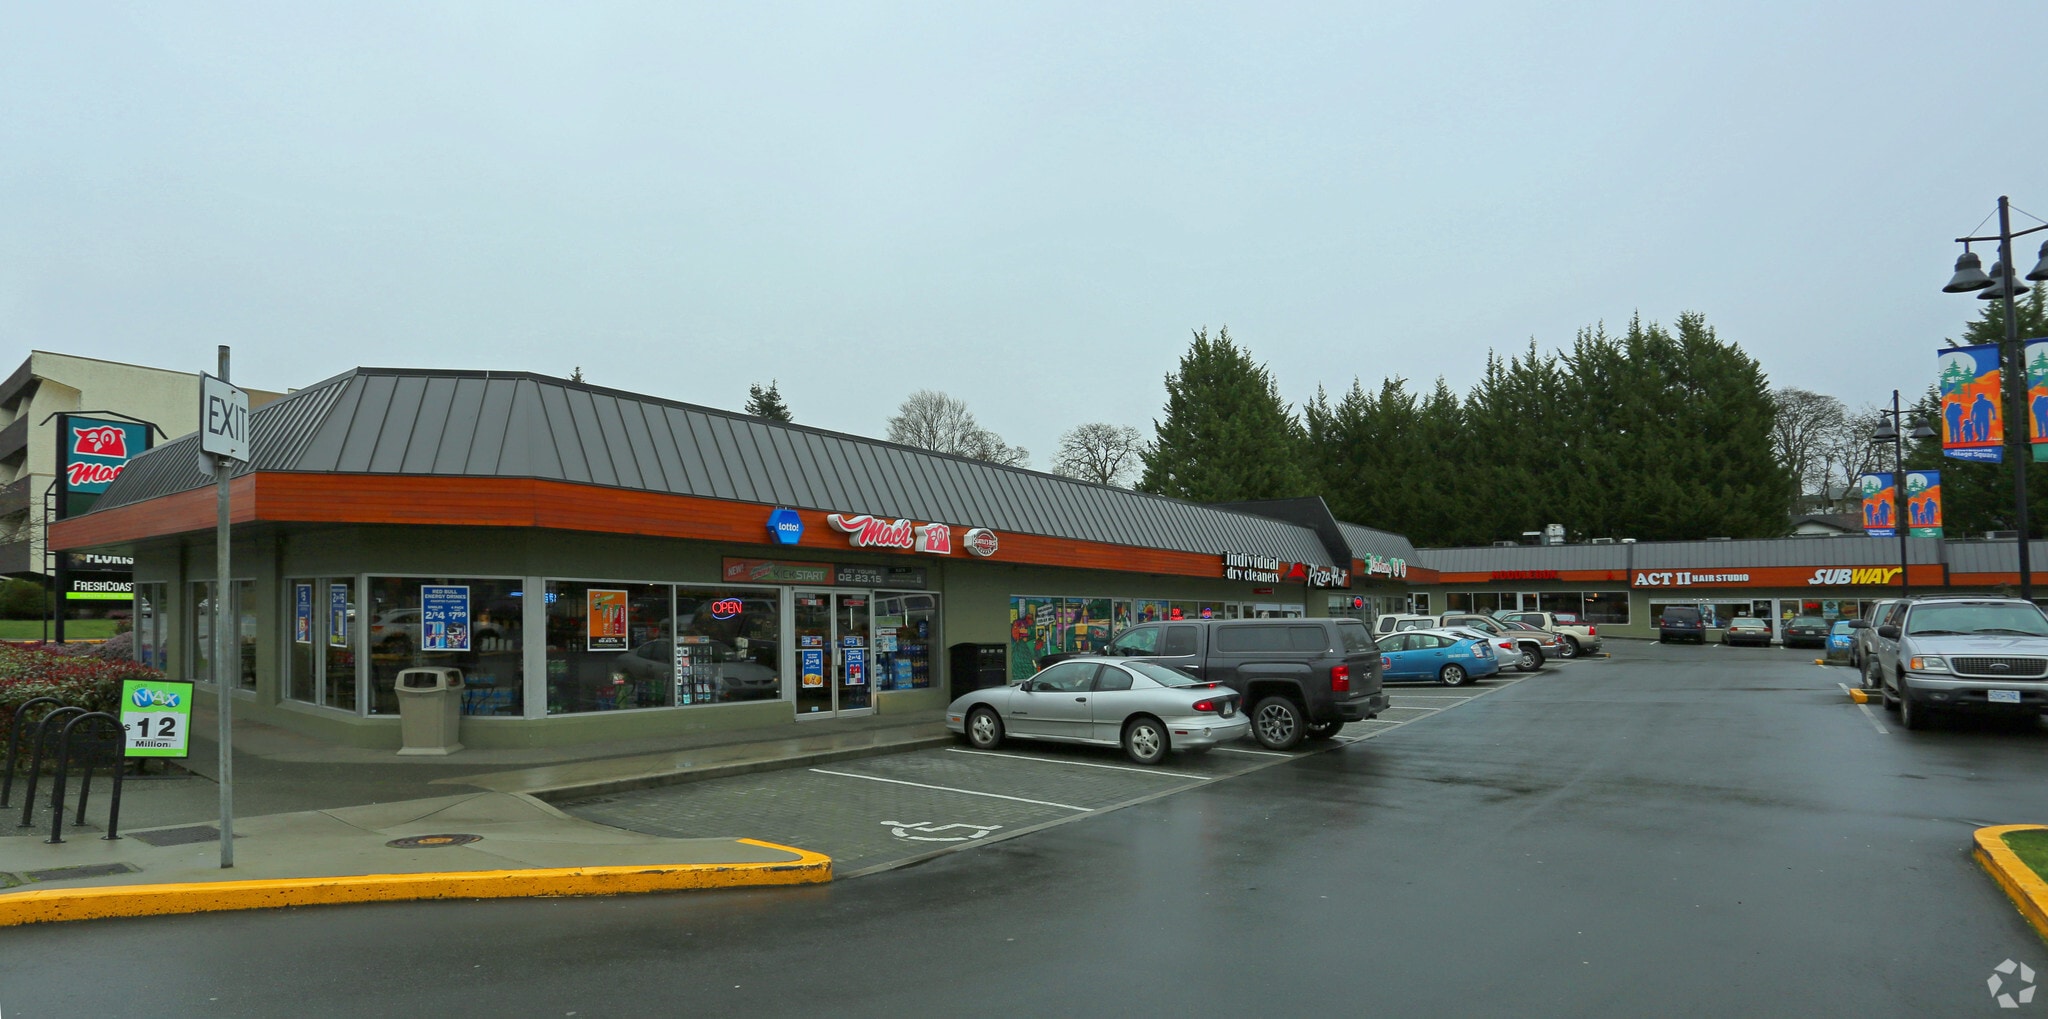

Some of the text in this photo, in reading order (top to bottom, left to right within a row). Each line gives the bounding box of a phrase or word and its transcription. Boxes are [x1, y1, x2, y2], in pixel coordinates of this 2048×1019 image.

[209, 395, 246, 443] EXIT
[778, 522, 799, 532] lotto!
[836, 515, 913, 548] Mac's
[1226, 550, 1279, 570] individual
[838, 574, 882, 584] 02.23.15
[1227, 566, 1279, 583] dry cleaners
[1307, 563, 1331, 587] Pizza
[1331, 565, 1347, 587] Hut
[1635, 573, 1673, 586] ACT
[1676, 572, 1691, 585] II
[1716, 574, 1750, 582] STUDIO
[1808, 566, 1903, 585] SUBWAY
[74, 580, 134, 591] FRESHCOAS
[712, 601, 742, 614] OPEN
[133, 689, 178, 707] MAX
